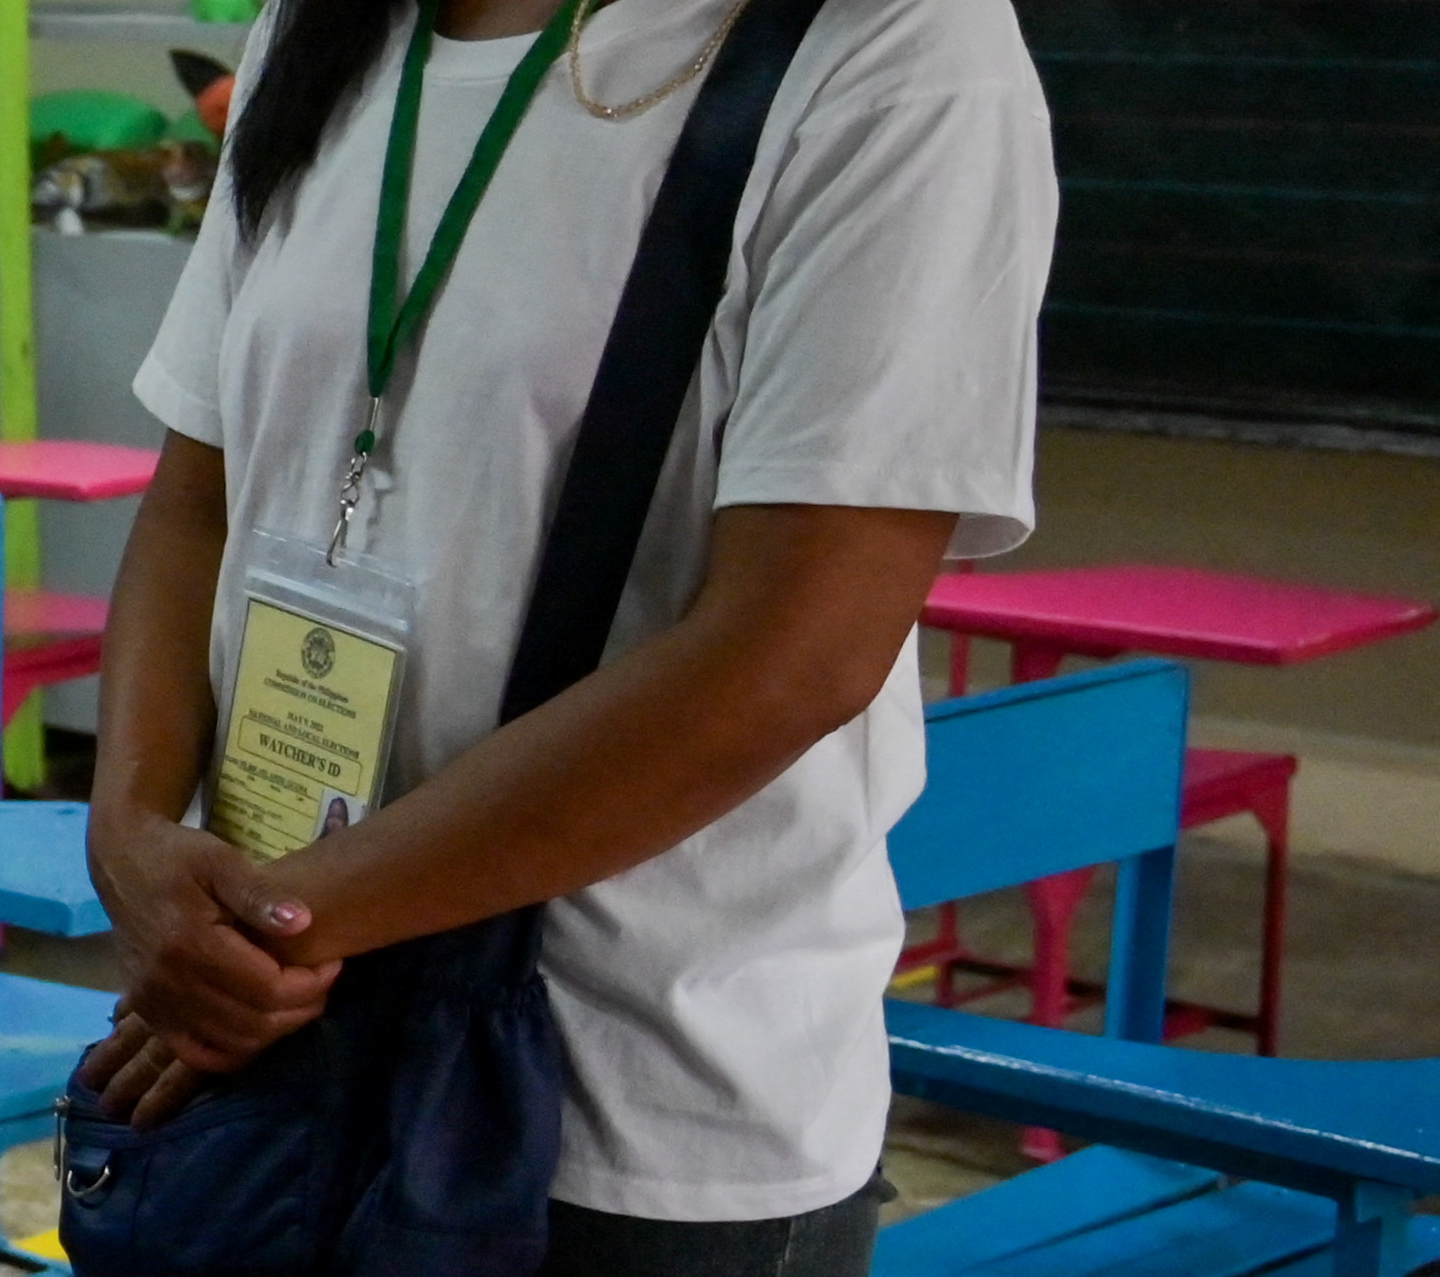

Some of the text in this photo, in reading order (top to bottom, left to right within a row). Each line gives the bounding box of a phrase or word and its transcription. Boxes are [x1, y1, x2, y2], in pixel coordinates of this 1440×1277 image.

[318, 698, 357, 719] ELECTIONS
[259, 733, 342, 778] WATCHER'S ID
